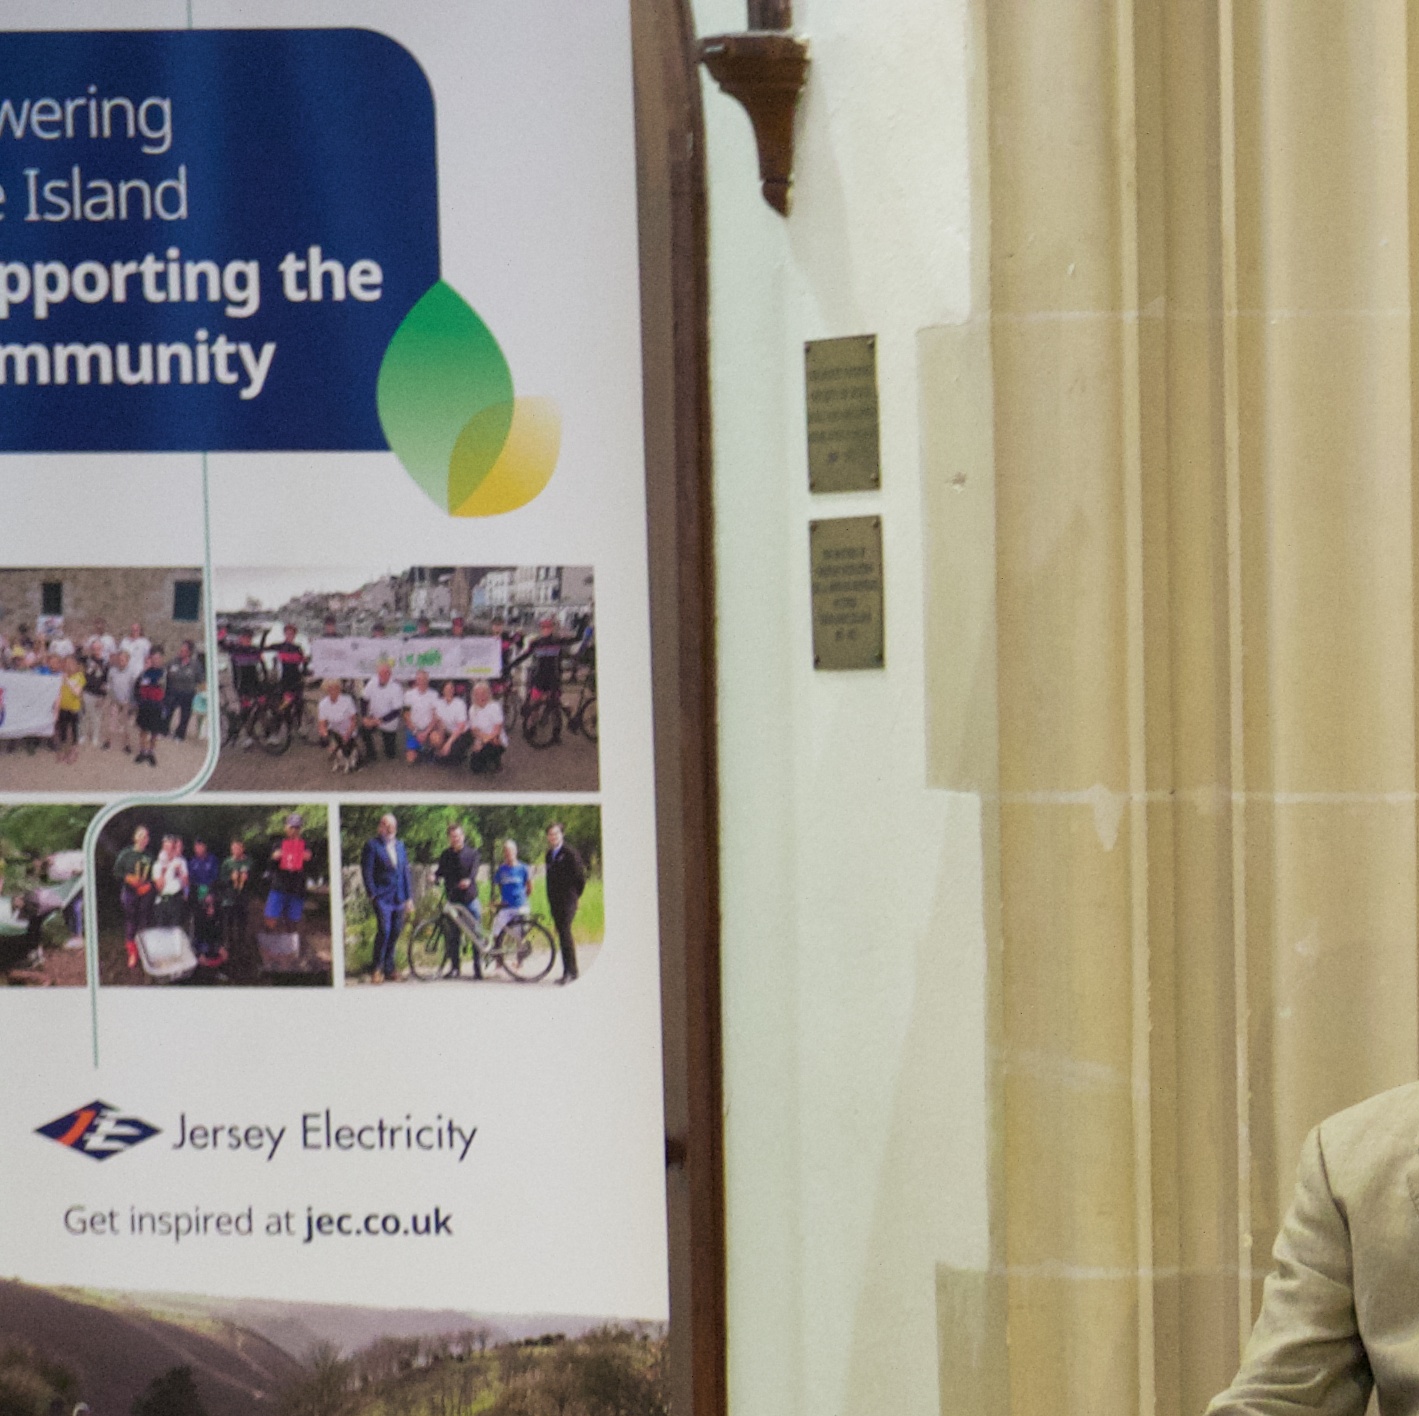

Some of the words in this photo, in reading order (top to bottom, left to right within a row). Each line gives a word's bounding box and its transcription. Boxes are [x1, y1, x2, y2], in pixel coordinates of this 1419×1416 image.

[25, 165, 188, 222] Island
[280, 246, 382, 301] the
[173, 1112, 286, 1161] Jersey
[302, 1109, 478, 1162] Electricity
[64, 1205, 117, 1234] Get
[130, 1206, 253, 1242] inspired
[265, 1211, 293, 1234] at
[304, 1207, 451, 1243] jec.co.uk
